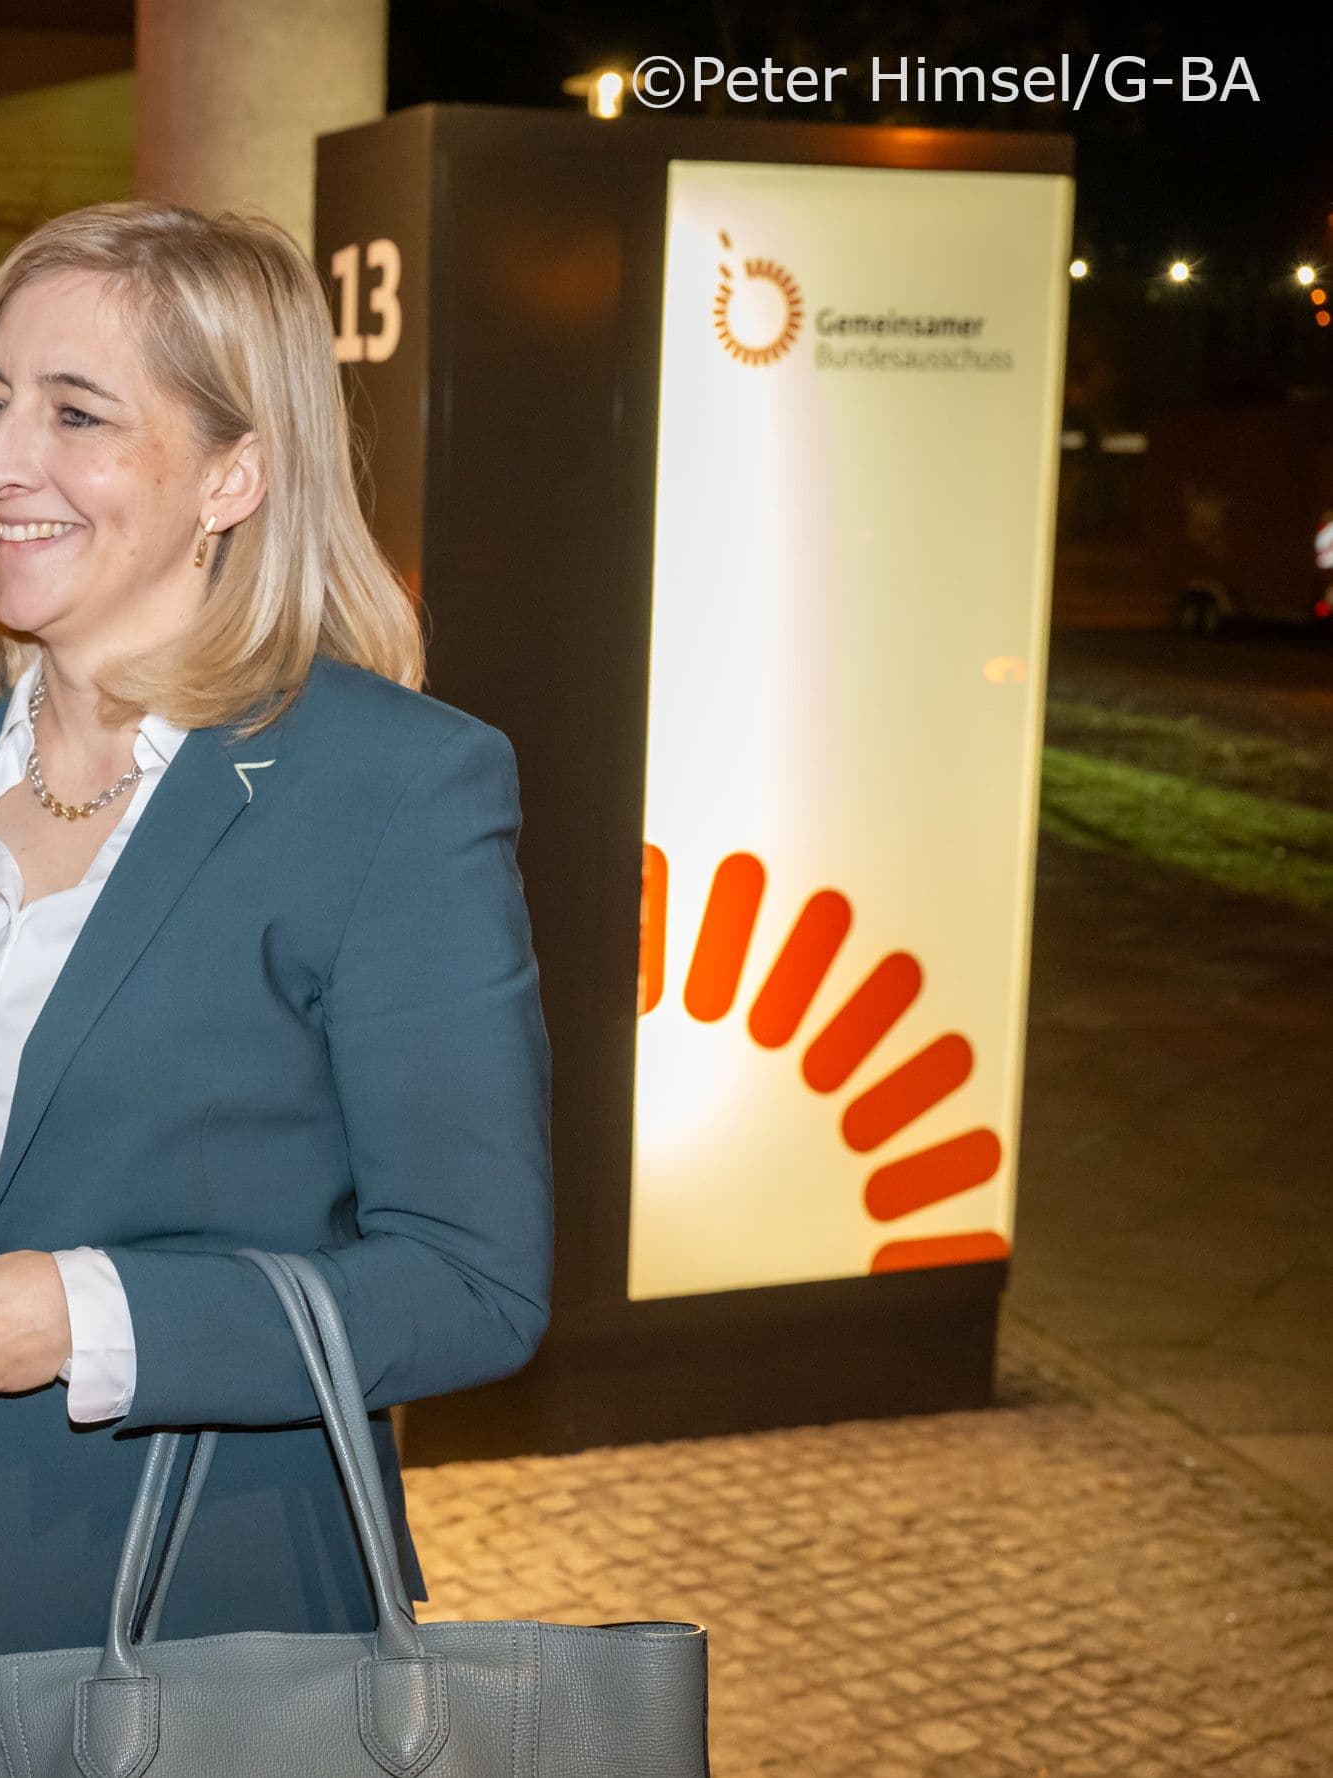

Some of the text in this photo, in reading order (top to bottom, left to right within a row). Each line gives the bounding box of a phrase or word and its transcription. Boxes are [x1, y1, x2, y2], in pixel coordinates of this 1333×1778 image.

[332, 238, 402, 362] 13
[816, 307, 984, 337] Gemeinsamer
[815, 344, 1013, 371] Bundesausschuss
